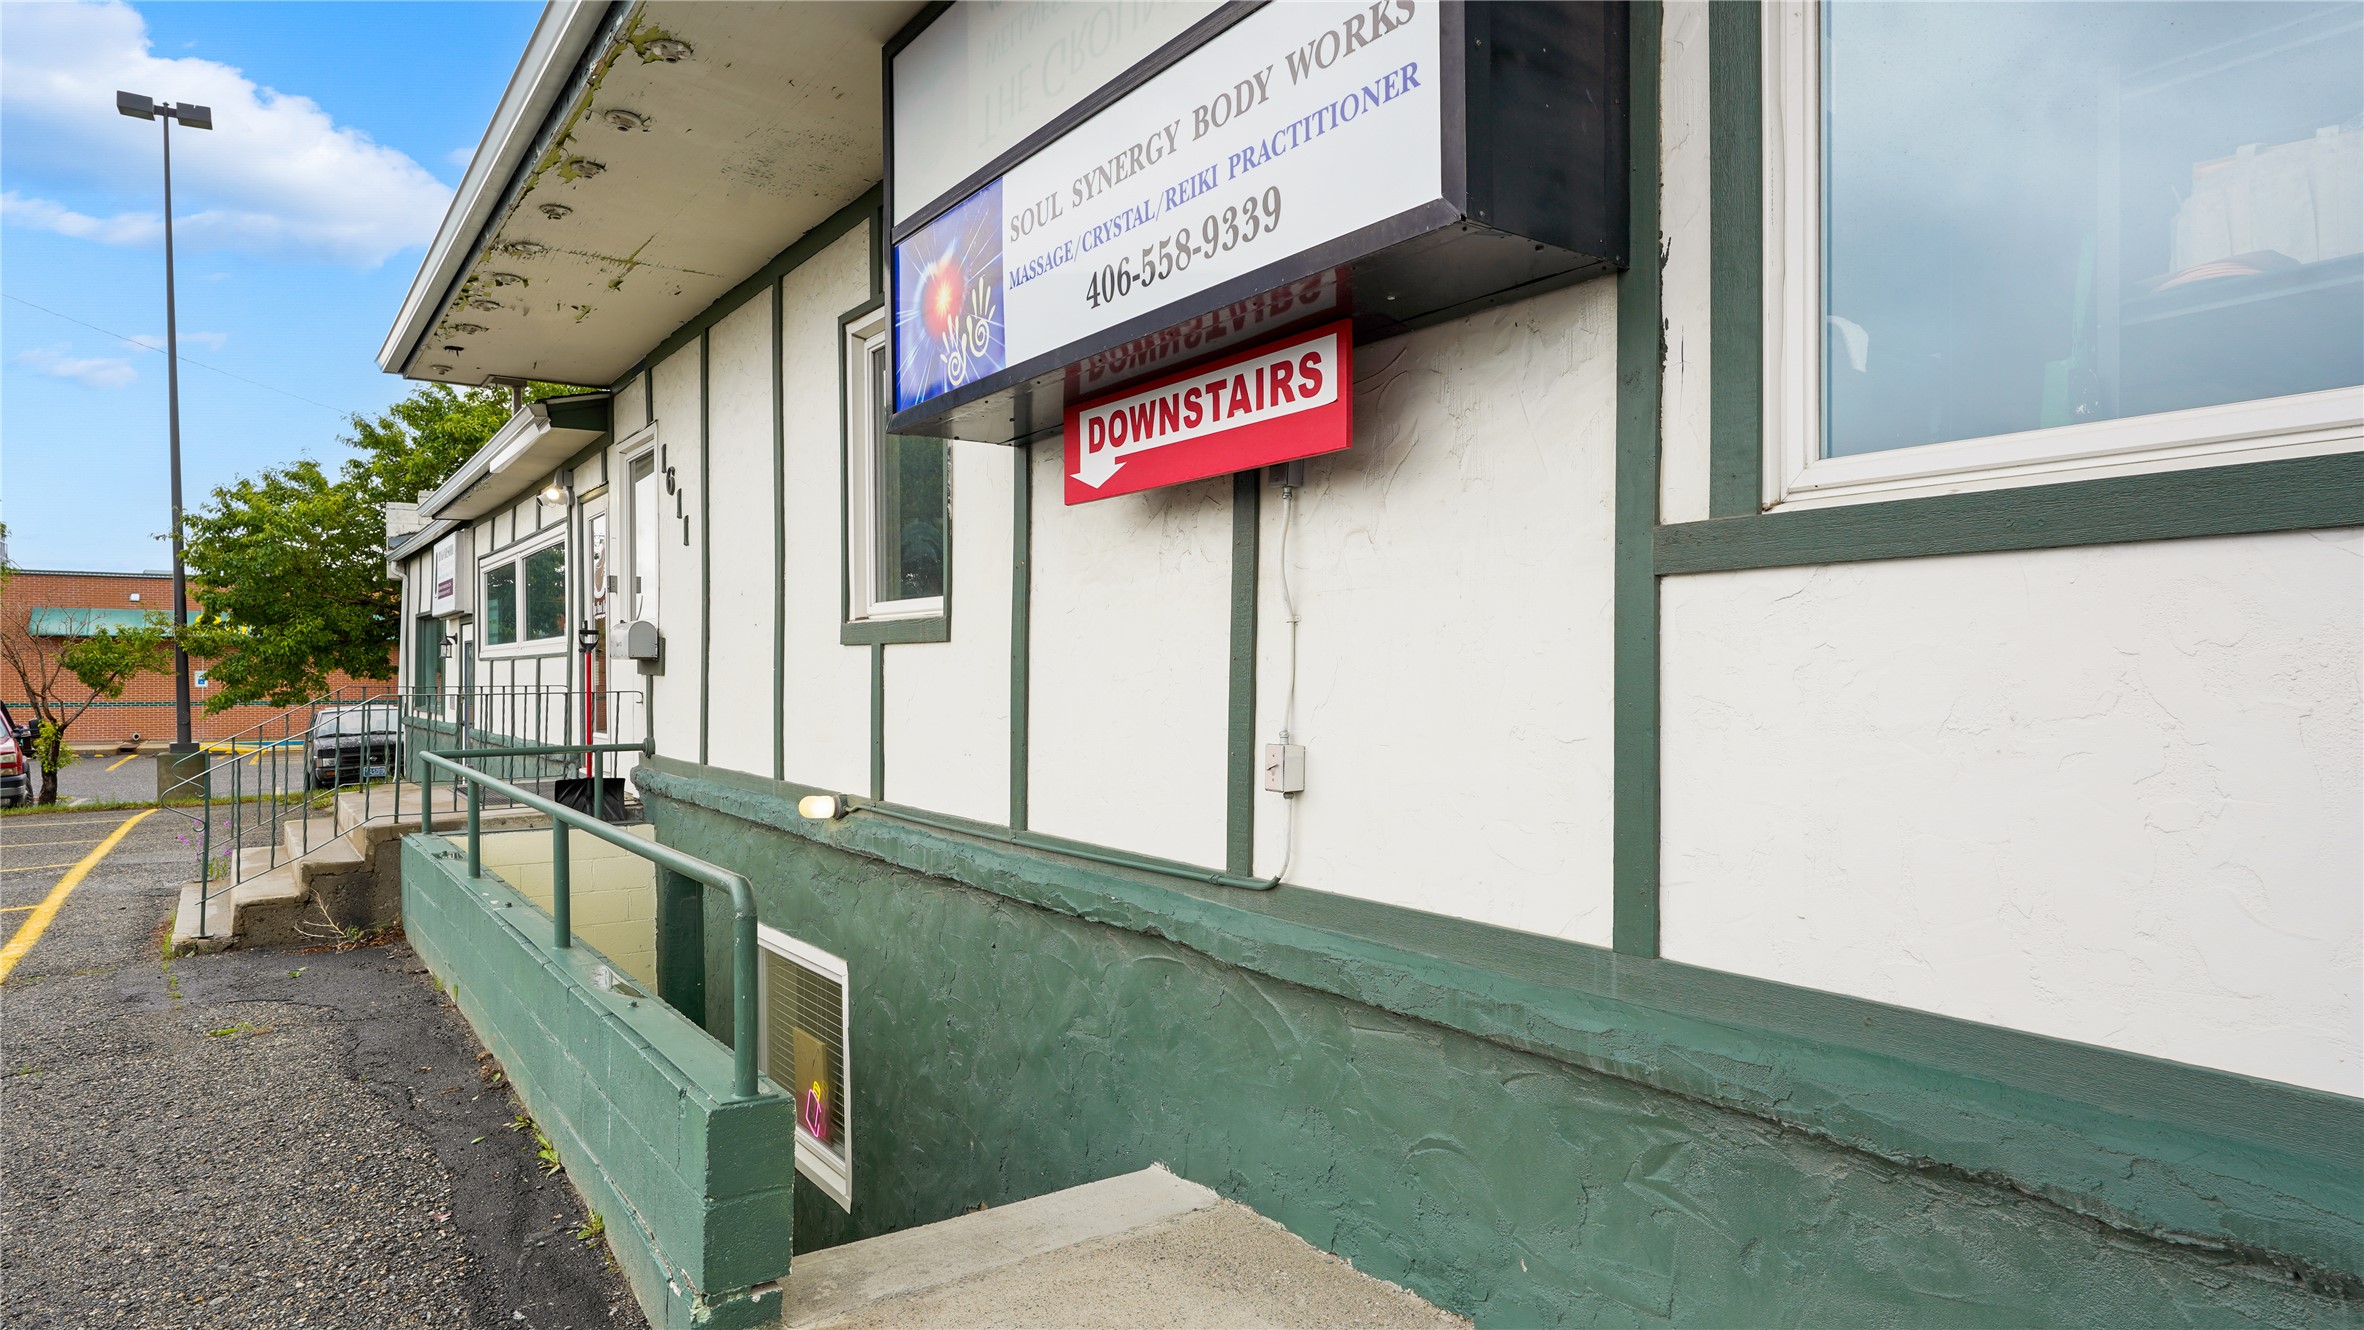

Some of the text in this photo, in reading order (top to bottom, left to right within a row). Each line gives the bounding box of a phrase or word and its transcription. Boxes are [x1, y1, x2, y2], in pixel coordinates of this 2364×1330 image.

[1009, 62, 1421, 290] MASSAGE/CRYSTAL/REIKI PRACTITIONER
[1010, 0, 1415, 243] SOUL SYNERGY BODY WORKS
[1086, 185, 1281, 309] 406-558-9339
[1088, 350, 1323, 455] DOWNSTAIRS
[662, 443, 689, 546] 1611
